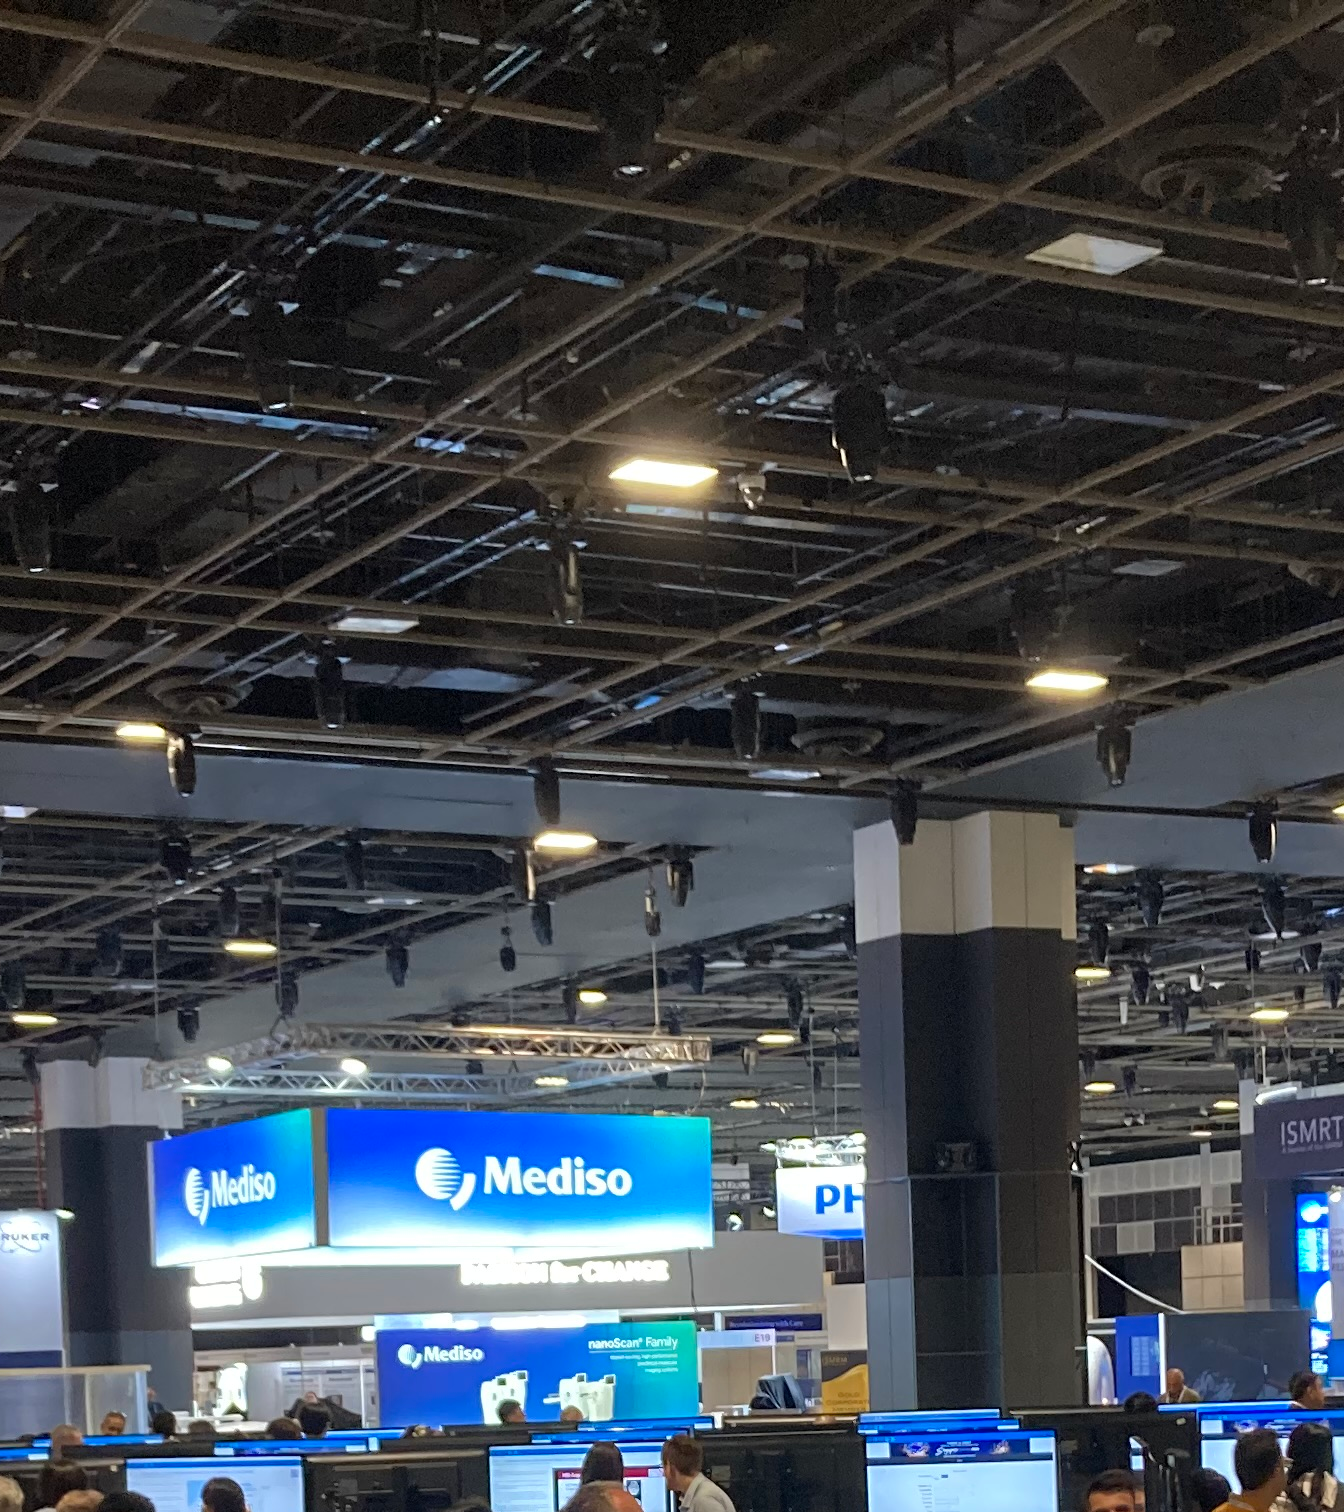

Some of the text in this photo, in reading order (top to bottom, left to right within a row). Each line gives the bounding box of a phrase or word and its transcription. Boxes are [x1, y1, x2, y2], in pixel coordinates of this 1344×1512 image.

[1281, 1116, 1344, 1145] ISMRT
[210, 1163, 276, 1208] Mediso
[483, 1156, 632, 1197] Mediso
[816, 1184, 863, 1214] PH
[424, 1345, 484, 1363] Mediso
[646, 1336, 678, 1350] Family
